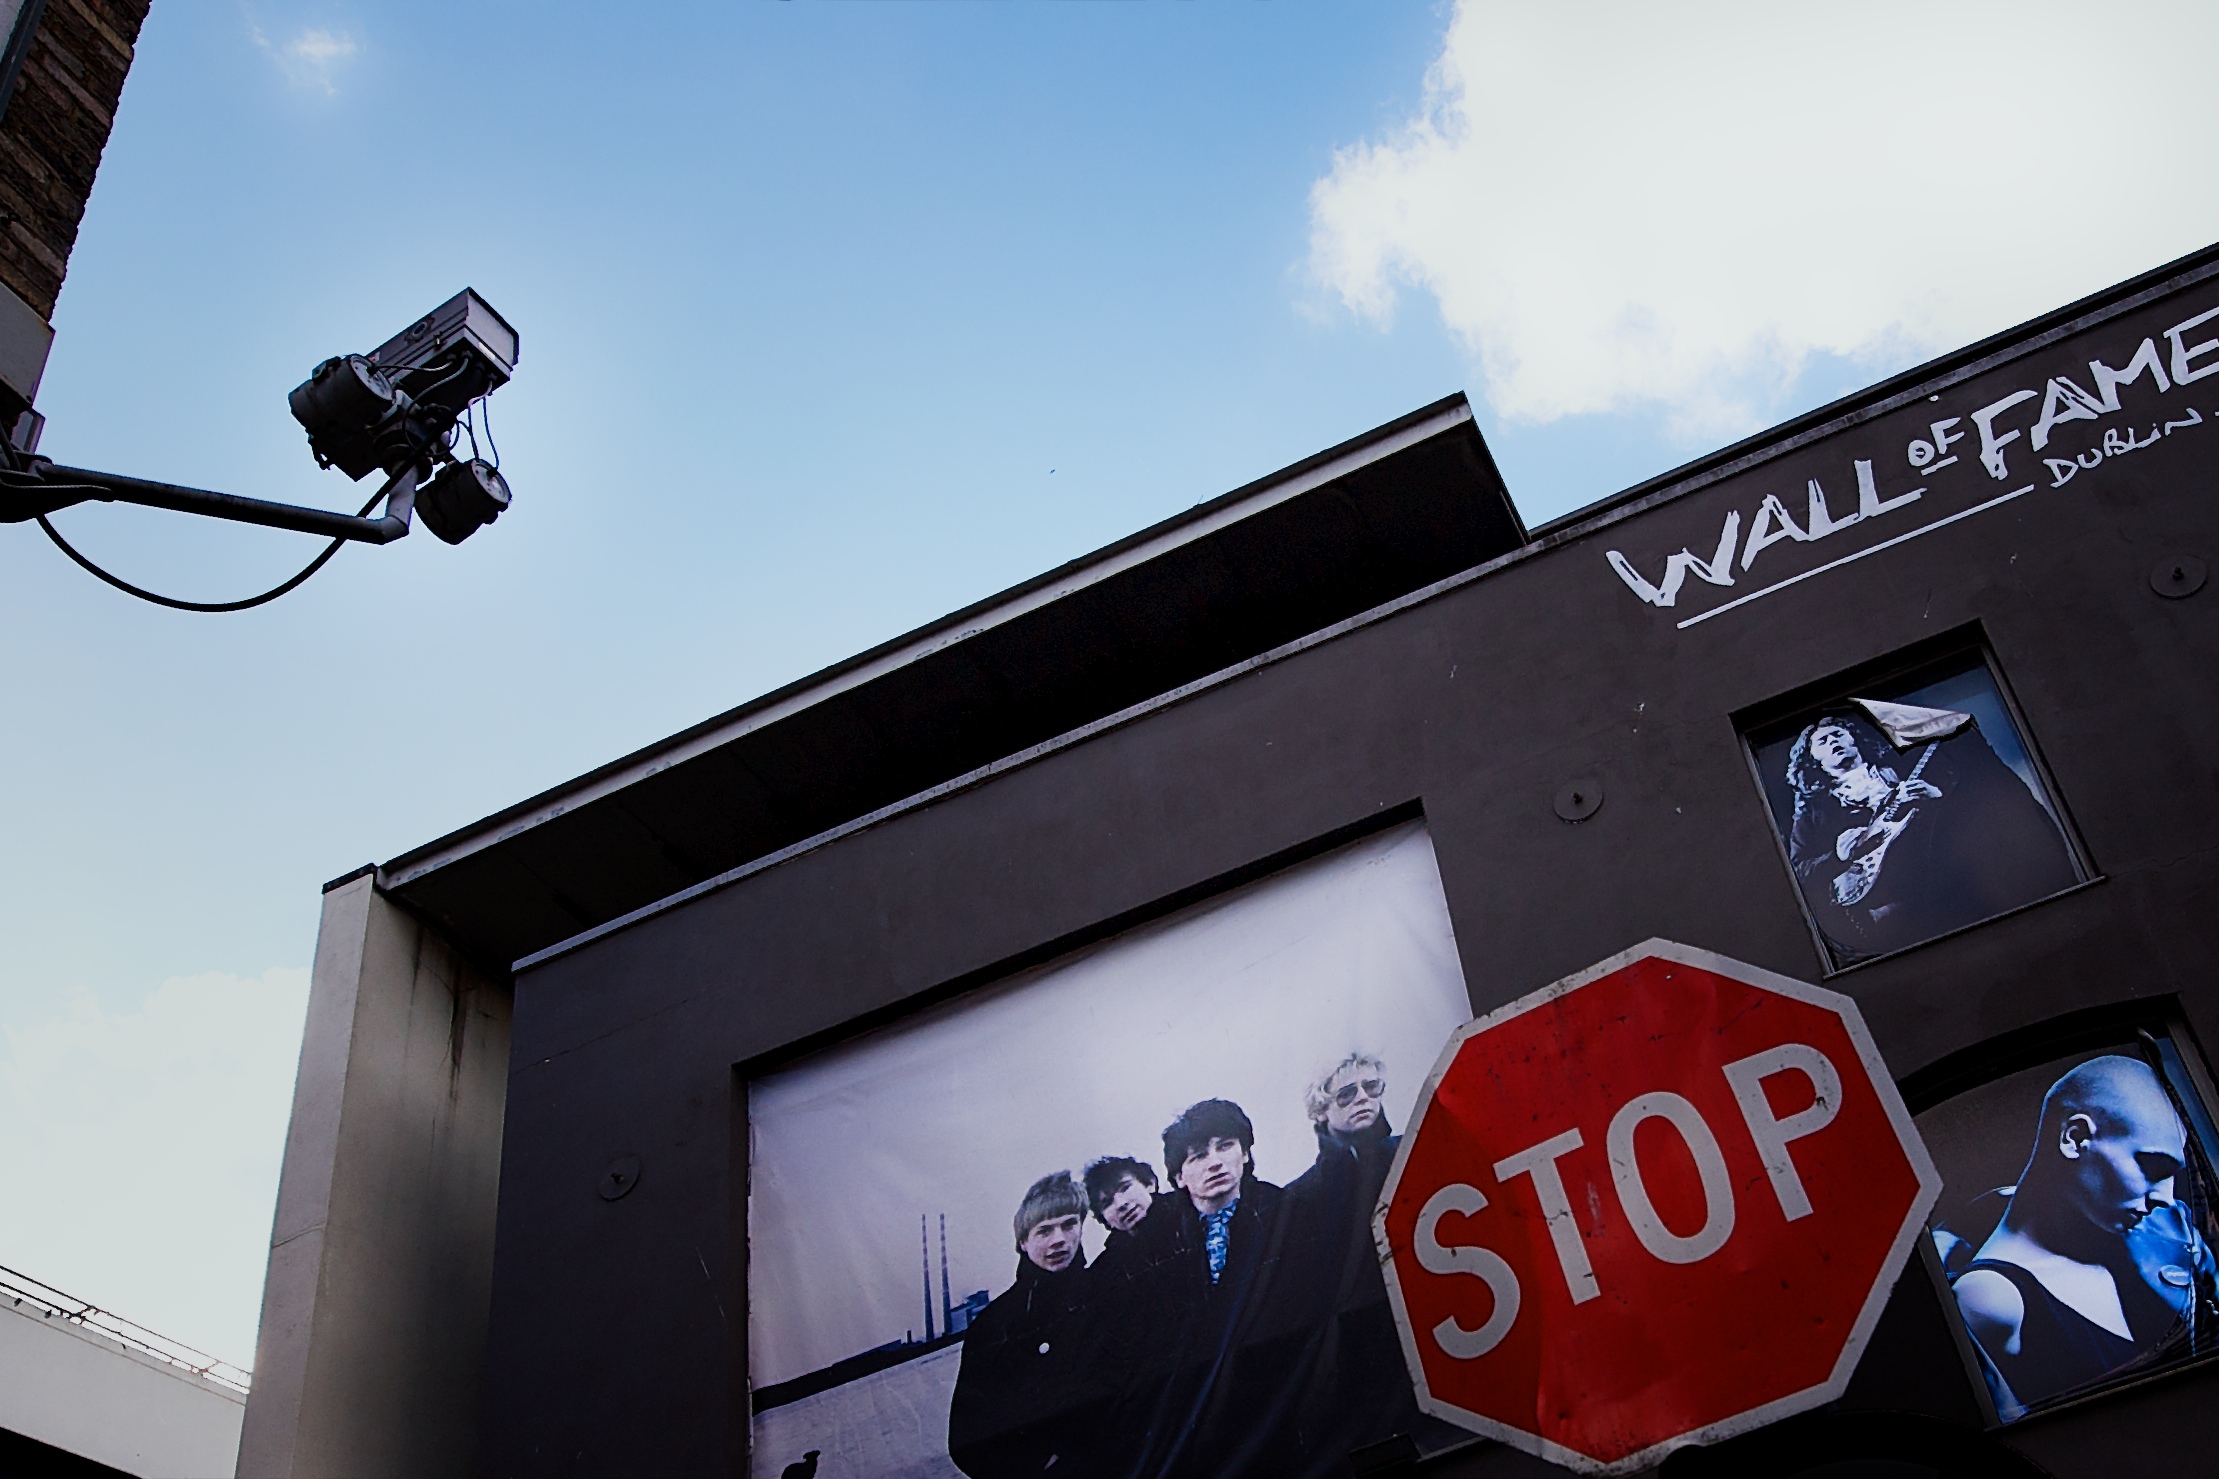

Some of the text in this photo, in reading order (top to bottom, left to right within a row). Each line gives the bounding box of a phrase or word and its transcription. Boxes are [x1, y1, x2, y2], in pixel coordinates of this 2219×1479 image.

[1605, 306, 2219, 607] WALL OF FAME
[1413, 1043, 1843, 1359] STOP
